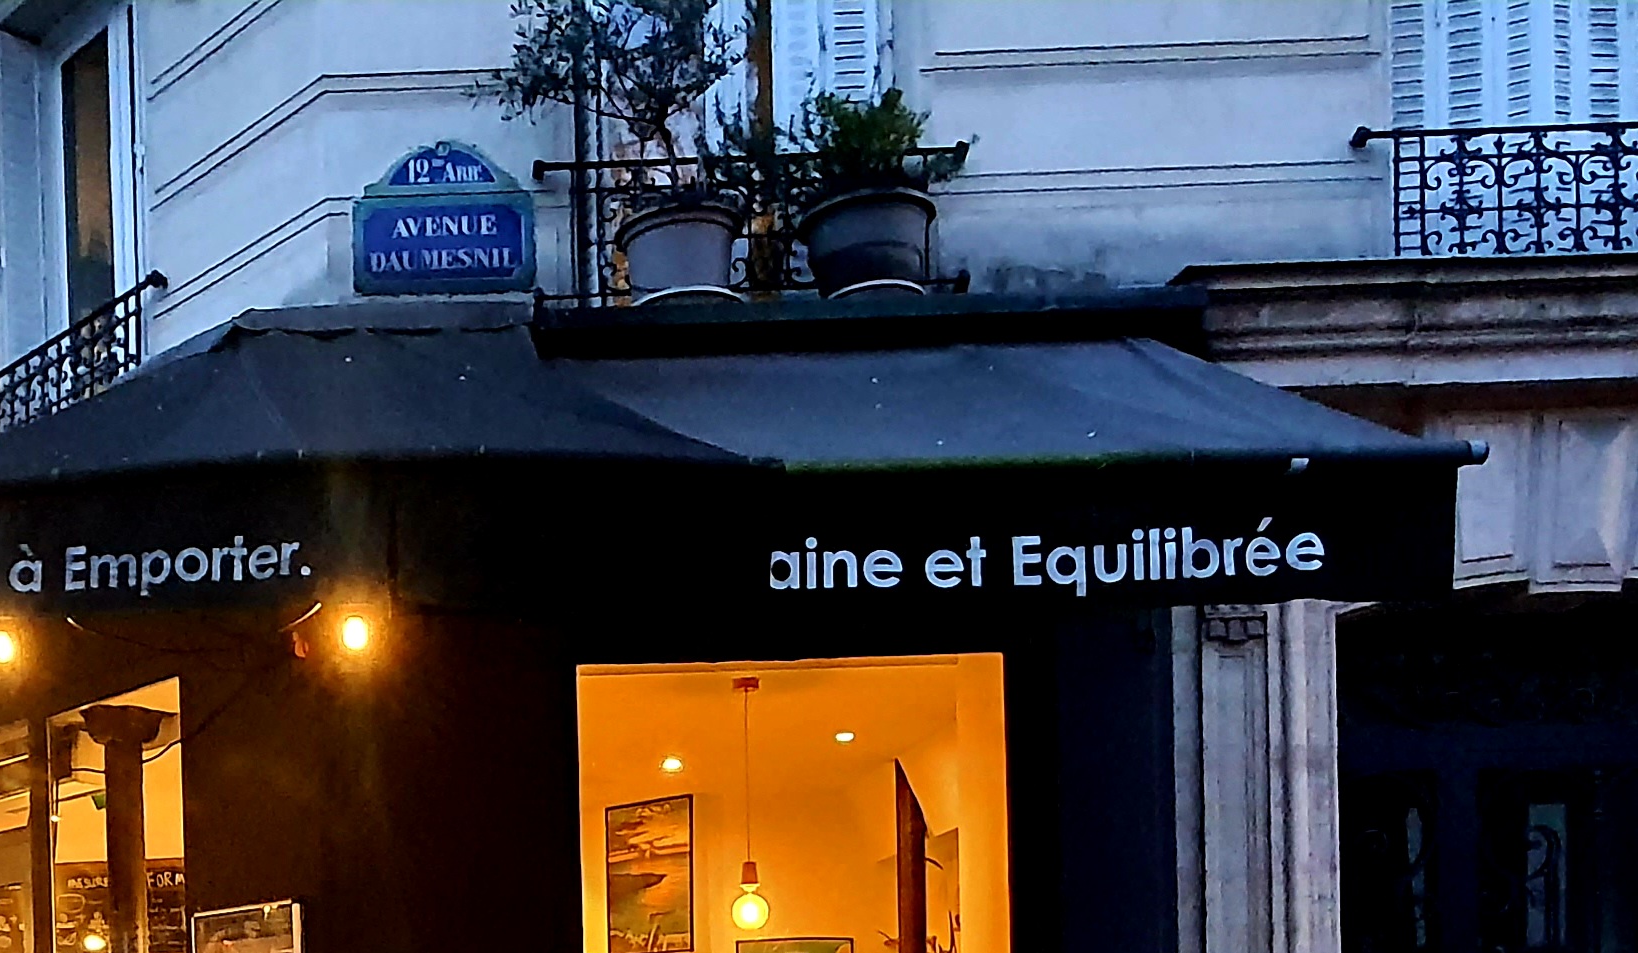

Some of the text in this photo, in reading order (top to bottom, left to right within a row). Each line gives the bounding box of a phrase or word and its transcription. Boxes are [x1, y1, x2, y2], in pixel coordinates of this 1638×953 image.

[391, 214, 498, 238] AVENUE
[369, 247, 518, 272] DAUMESNIL
[9, 544, 43, 593] à
[65, 536, 311, 597] Emporter.
[924, 535, 987, 588] et
[1011, 516, 1325, 597] Equilibrée
